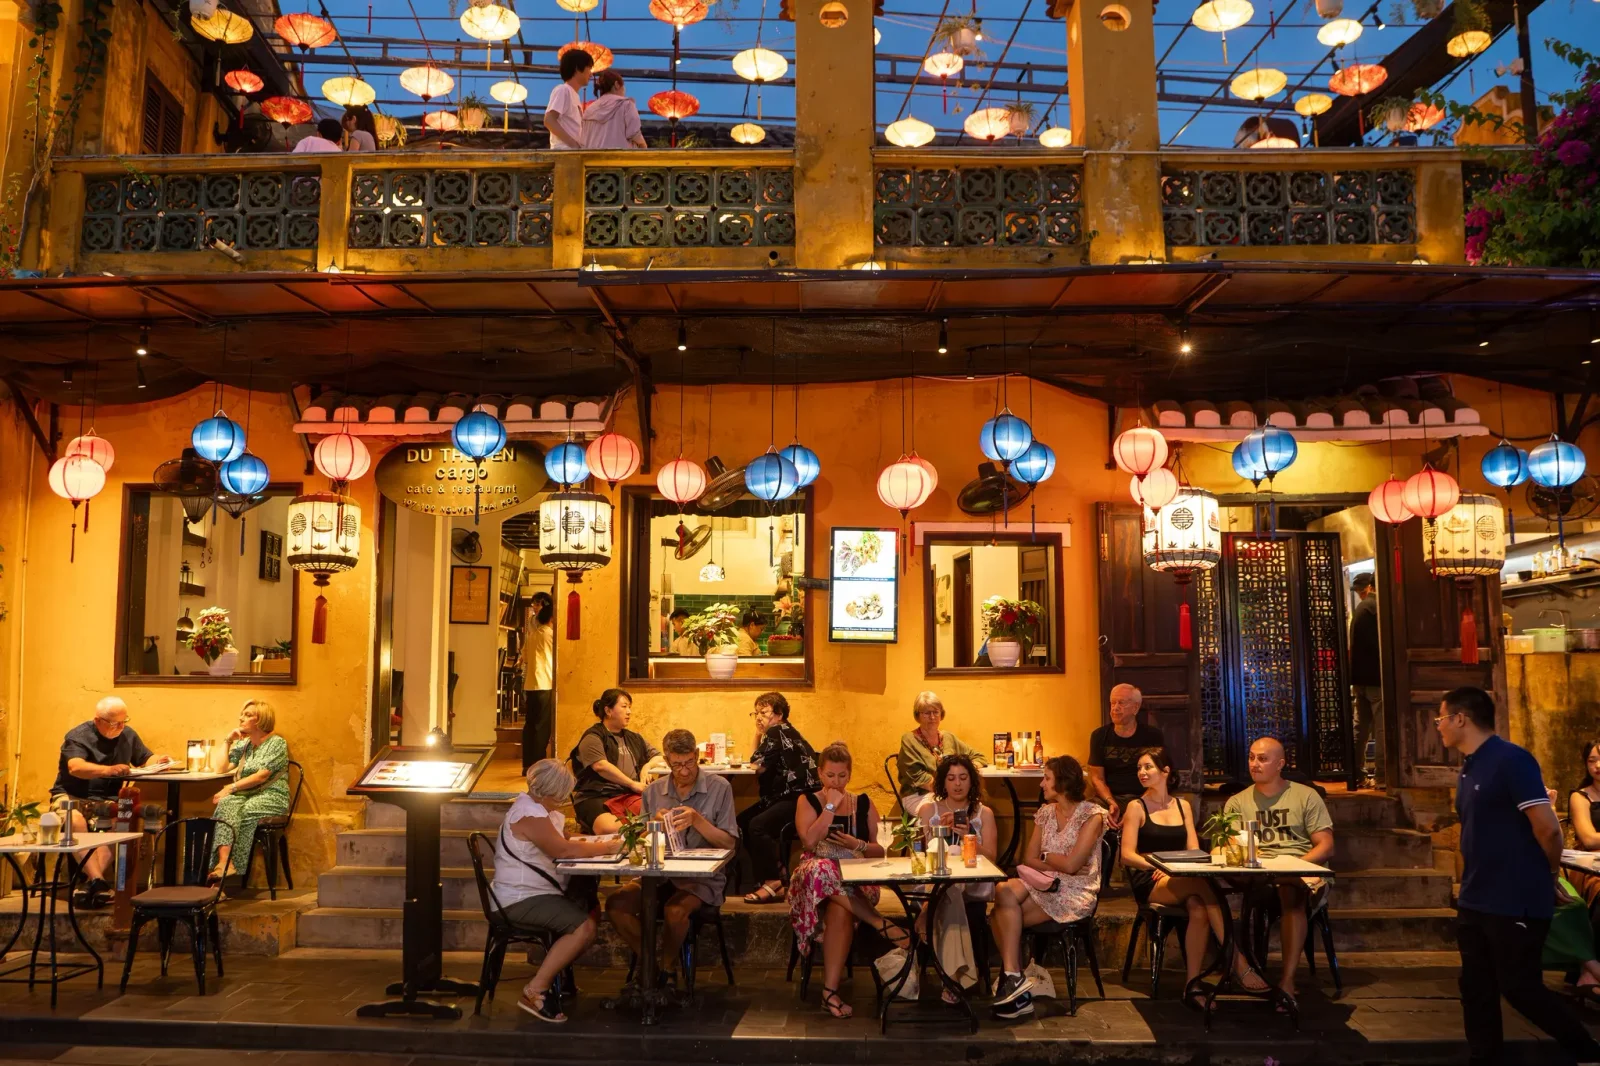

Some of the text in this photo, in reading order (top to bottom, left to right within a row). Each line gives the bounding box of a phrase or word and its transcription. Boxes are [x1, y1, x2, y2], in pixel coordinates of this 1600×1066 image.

[407, 447, 514, 462] DU THEN
[436, 467, 487, 482] cargo
[407, 484, 517, 493] cafe & restaurant
[1256, 808, 1289, 827] JUST
